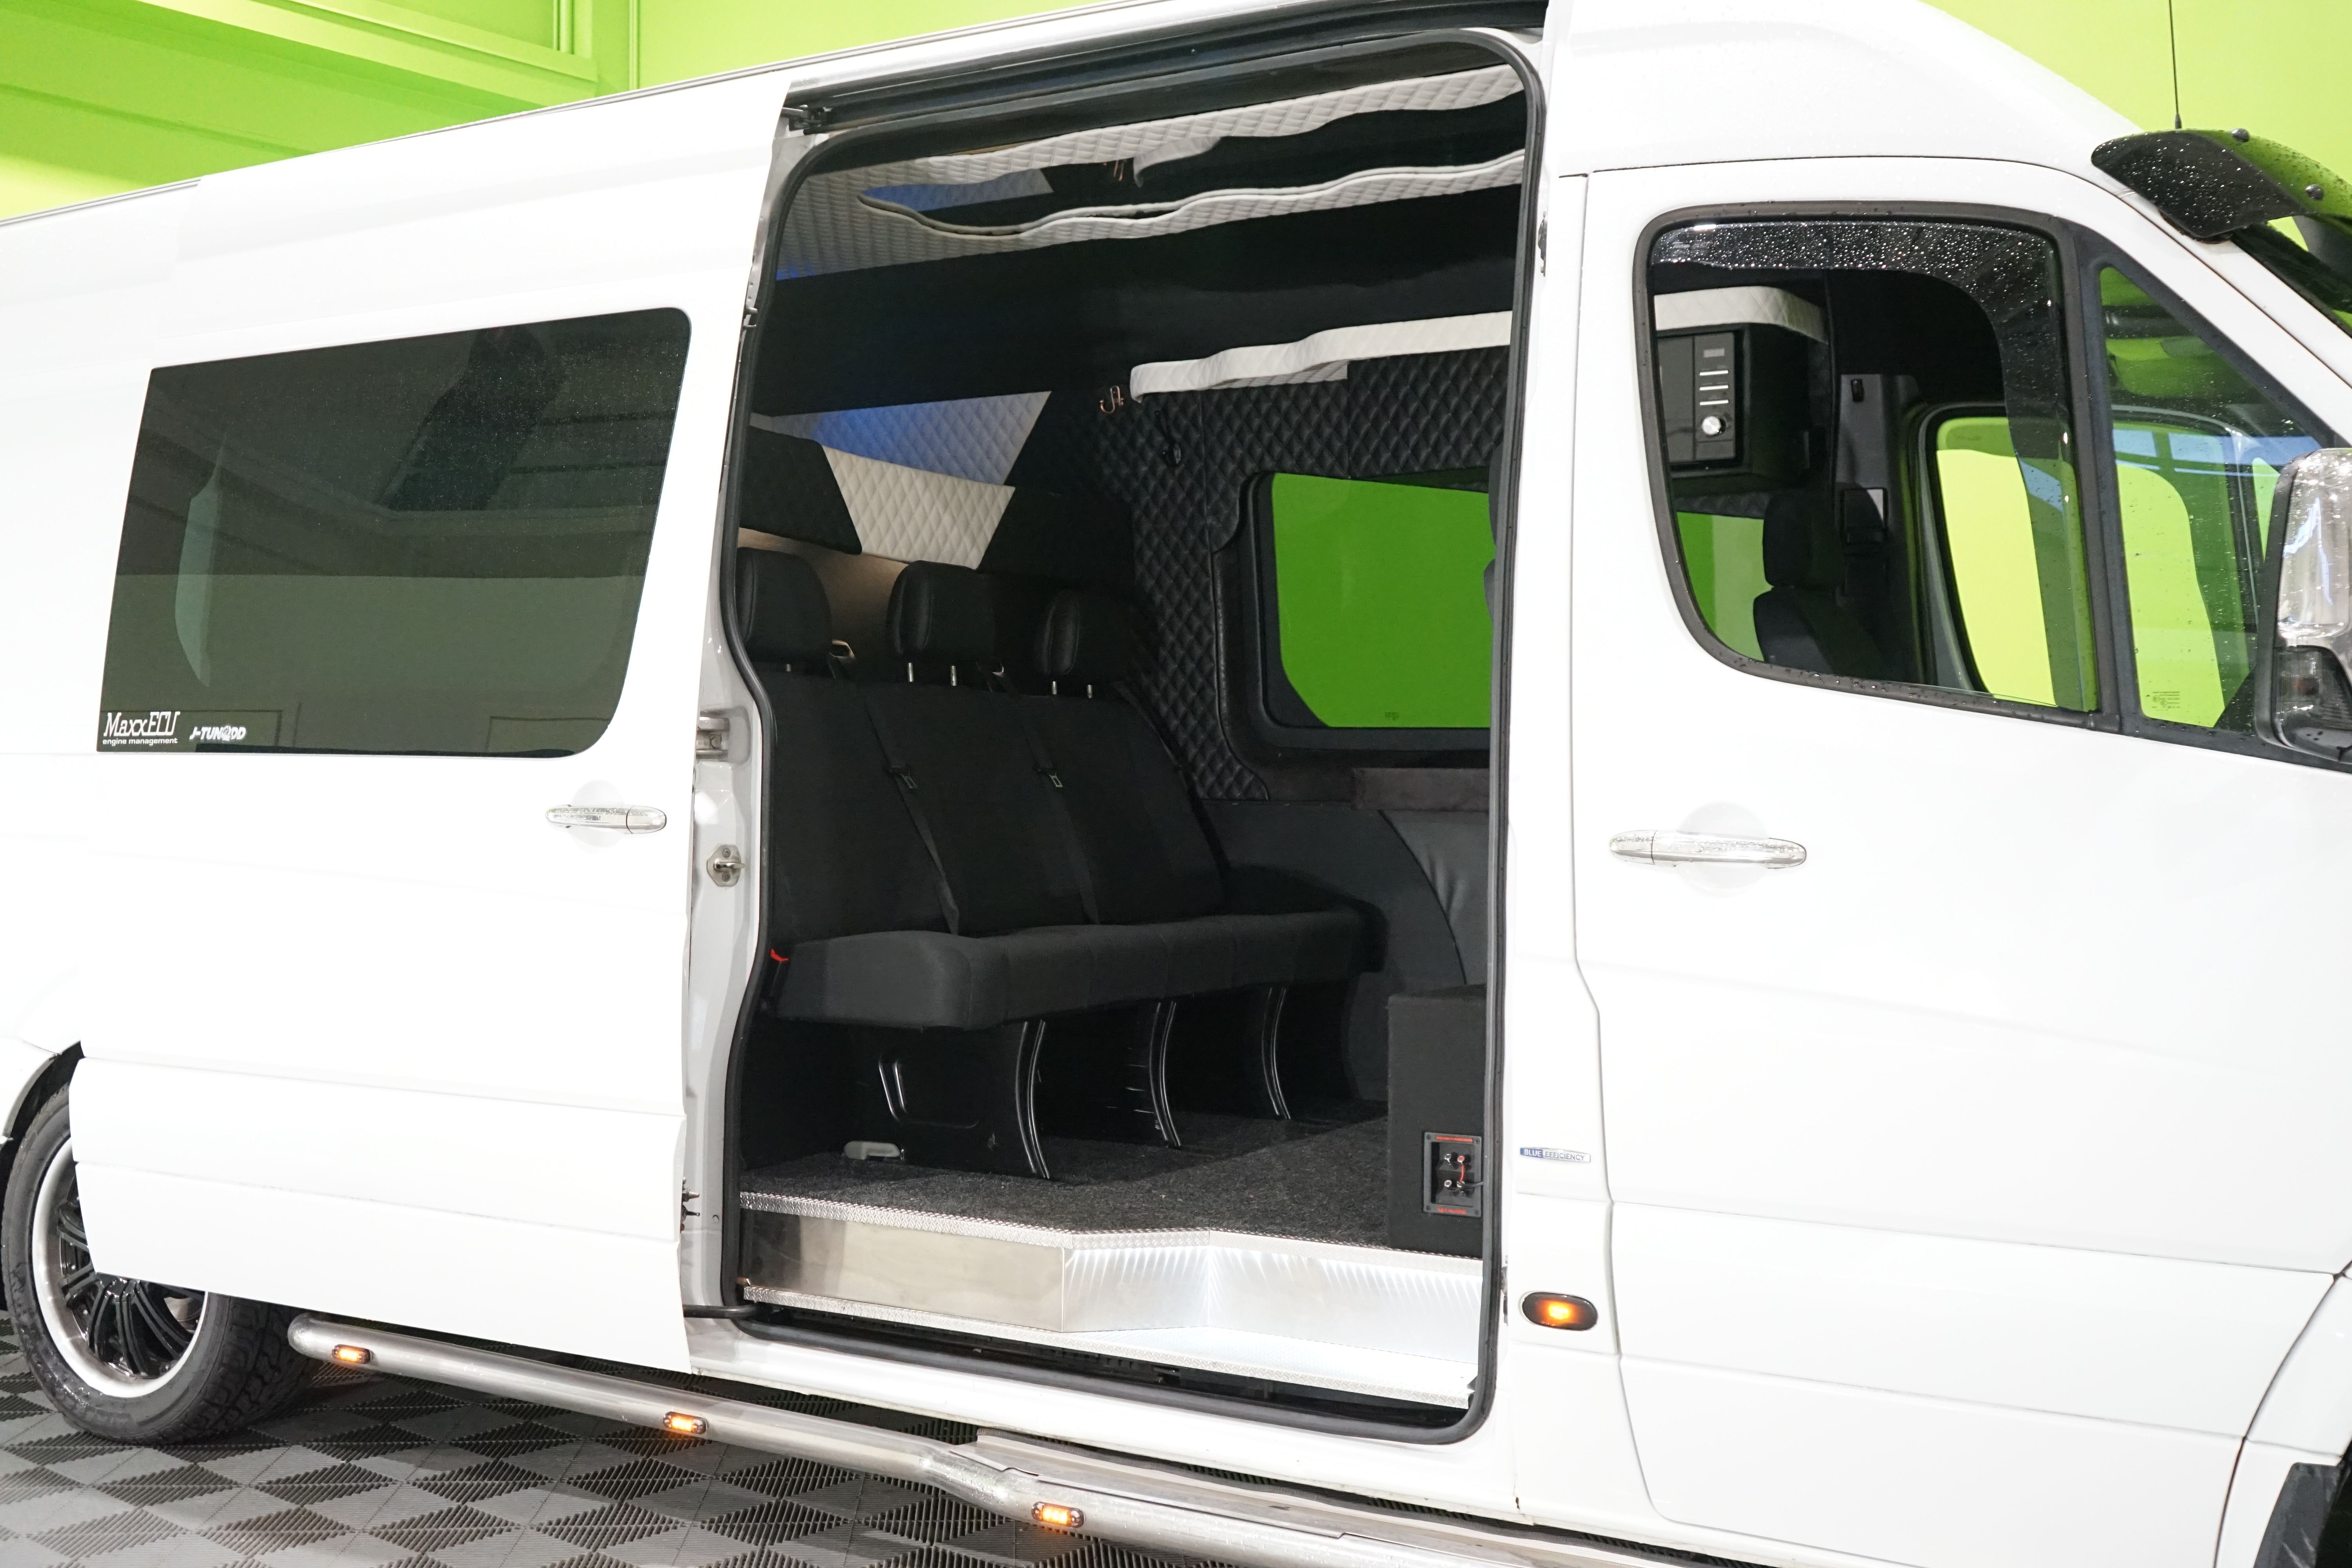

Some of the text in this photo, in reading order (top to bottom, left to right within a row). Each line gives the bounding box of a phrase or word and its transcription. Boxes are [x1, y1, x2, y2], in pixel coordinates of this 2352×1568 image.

[103, 711, 181, 737] MaxxECU
[102, 737, 178, 746] engine management
[1524, 1149, 1585, 1161] BLUE EFFICIENCY
